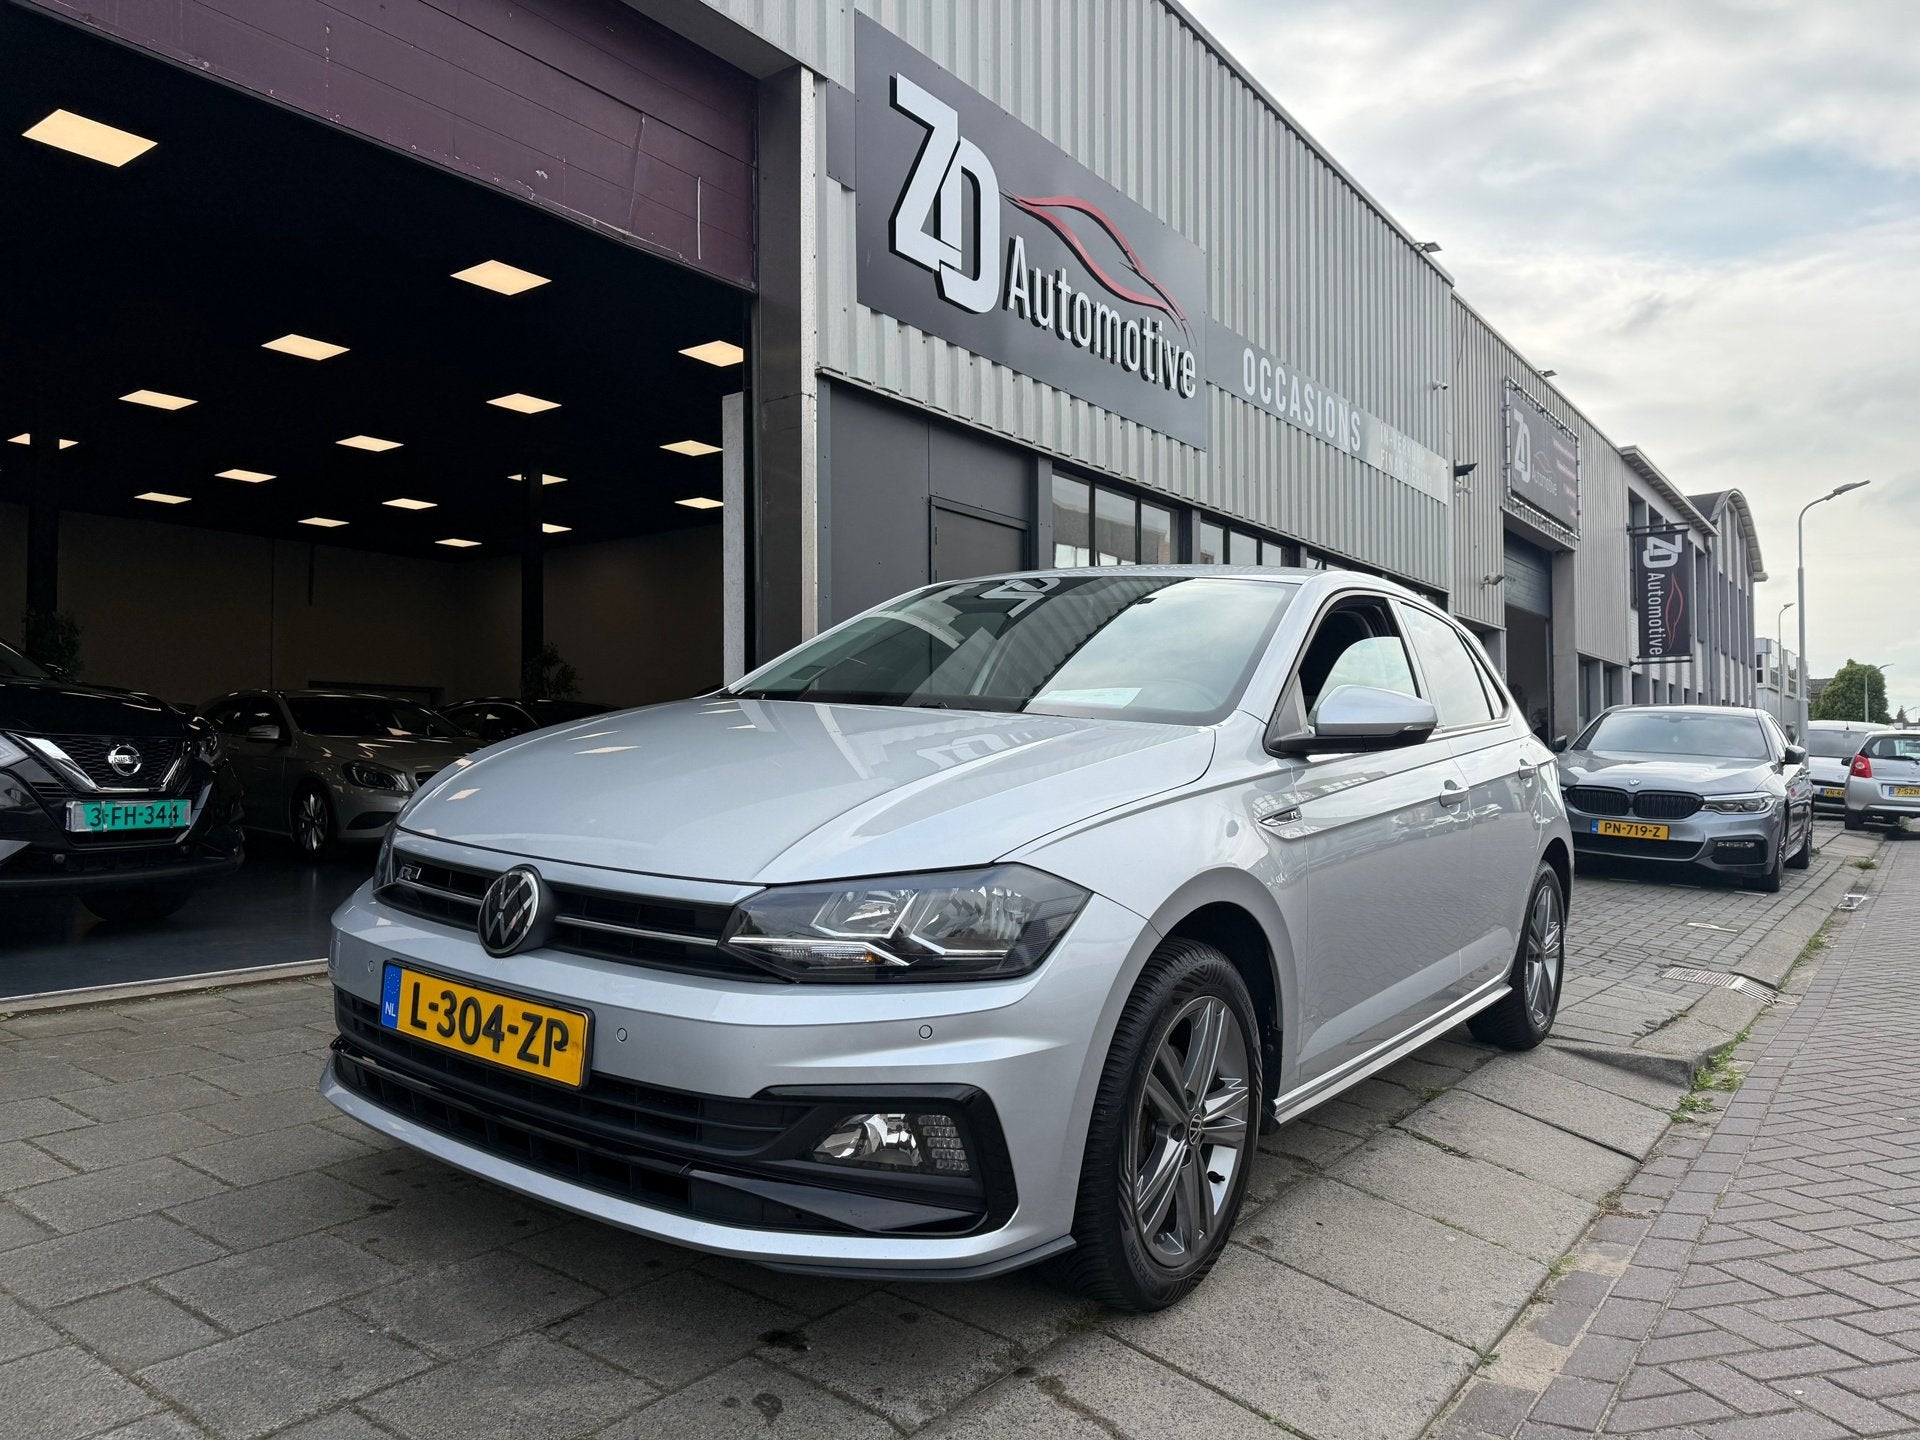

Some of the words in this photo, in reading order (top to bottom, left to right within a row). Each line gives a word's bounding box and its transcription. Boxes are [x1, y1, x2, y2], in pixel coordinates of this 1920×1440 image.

[895, 72, 1000, 313] ZD
[1007, 235, 1197, 399] Automotive
[1243, 347, 1361, 452] OCCASIONS
[1513, 408, 1531, 484] ZD
[1642, 534, 1683, 569] ZD
[1647, 572, 1666, 655] Automotive
[90, 804, 179, 827] 3-FH-344
[1604, 822, 1661, 838] PN-719-Z
[384, 1001, 397, 1018] NL
[410, 981, 569, 1068] L-304-ZP
